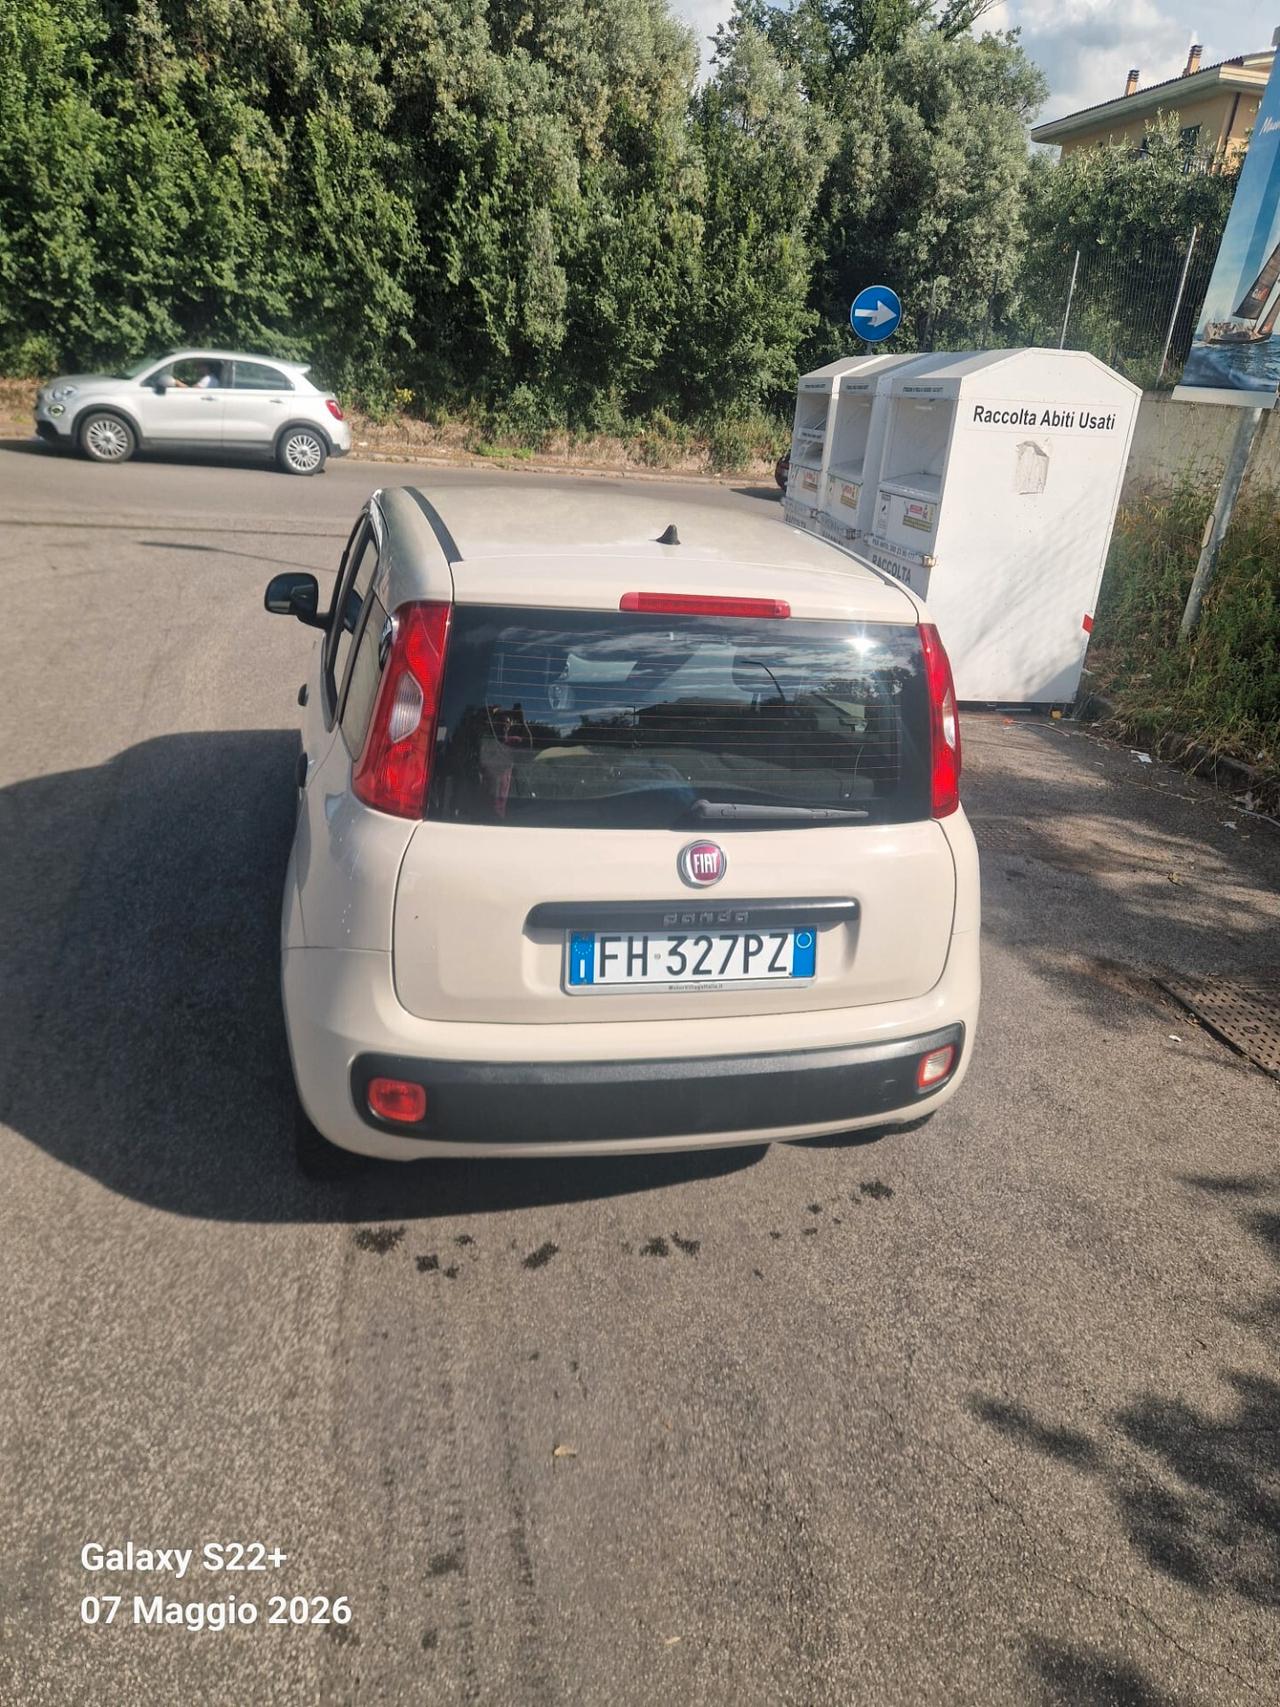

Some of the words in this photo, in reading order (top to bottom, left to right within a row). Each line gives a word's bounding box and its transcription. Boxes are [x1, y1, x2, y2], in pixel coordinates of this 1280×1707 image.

[973, 405, 1037, 425] Raccolta
[1040, 410, 1075, 428] Abiti
[1079, 412, 1116, 430] Usati
[872, 554, 911, 584] RACCOLTA
[693, 853, 719, 874] FIAT
[599, 935, 649, 978] FH
[665, 932, 789, 976] 327PZ
